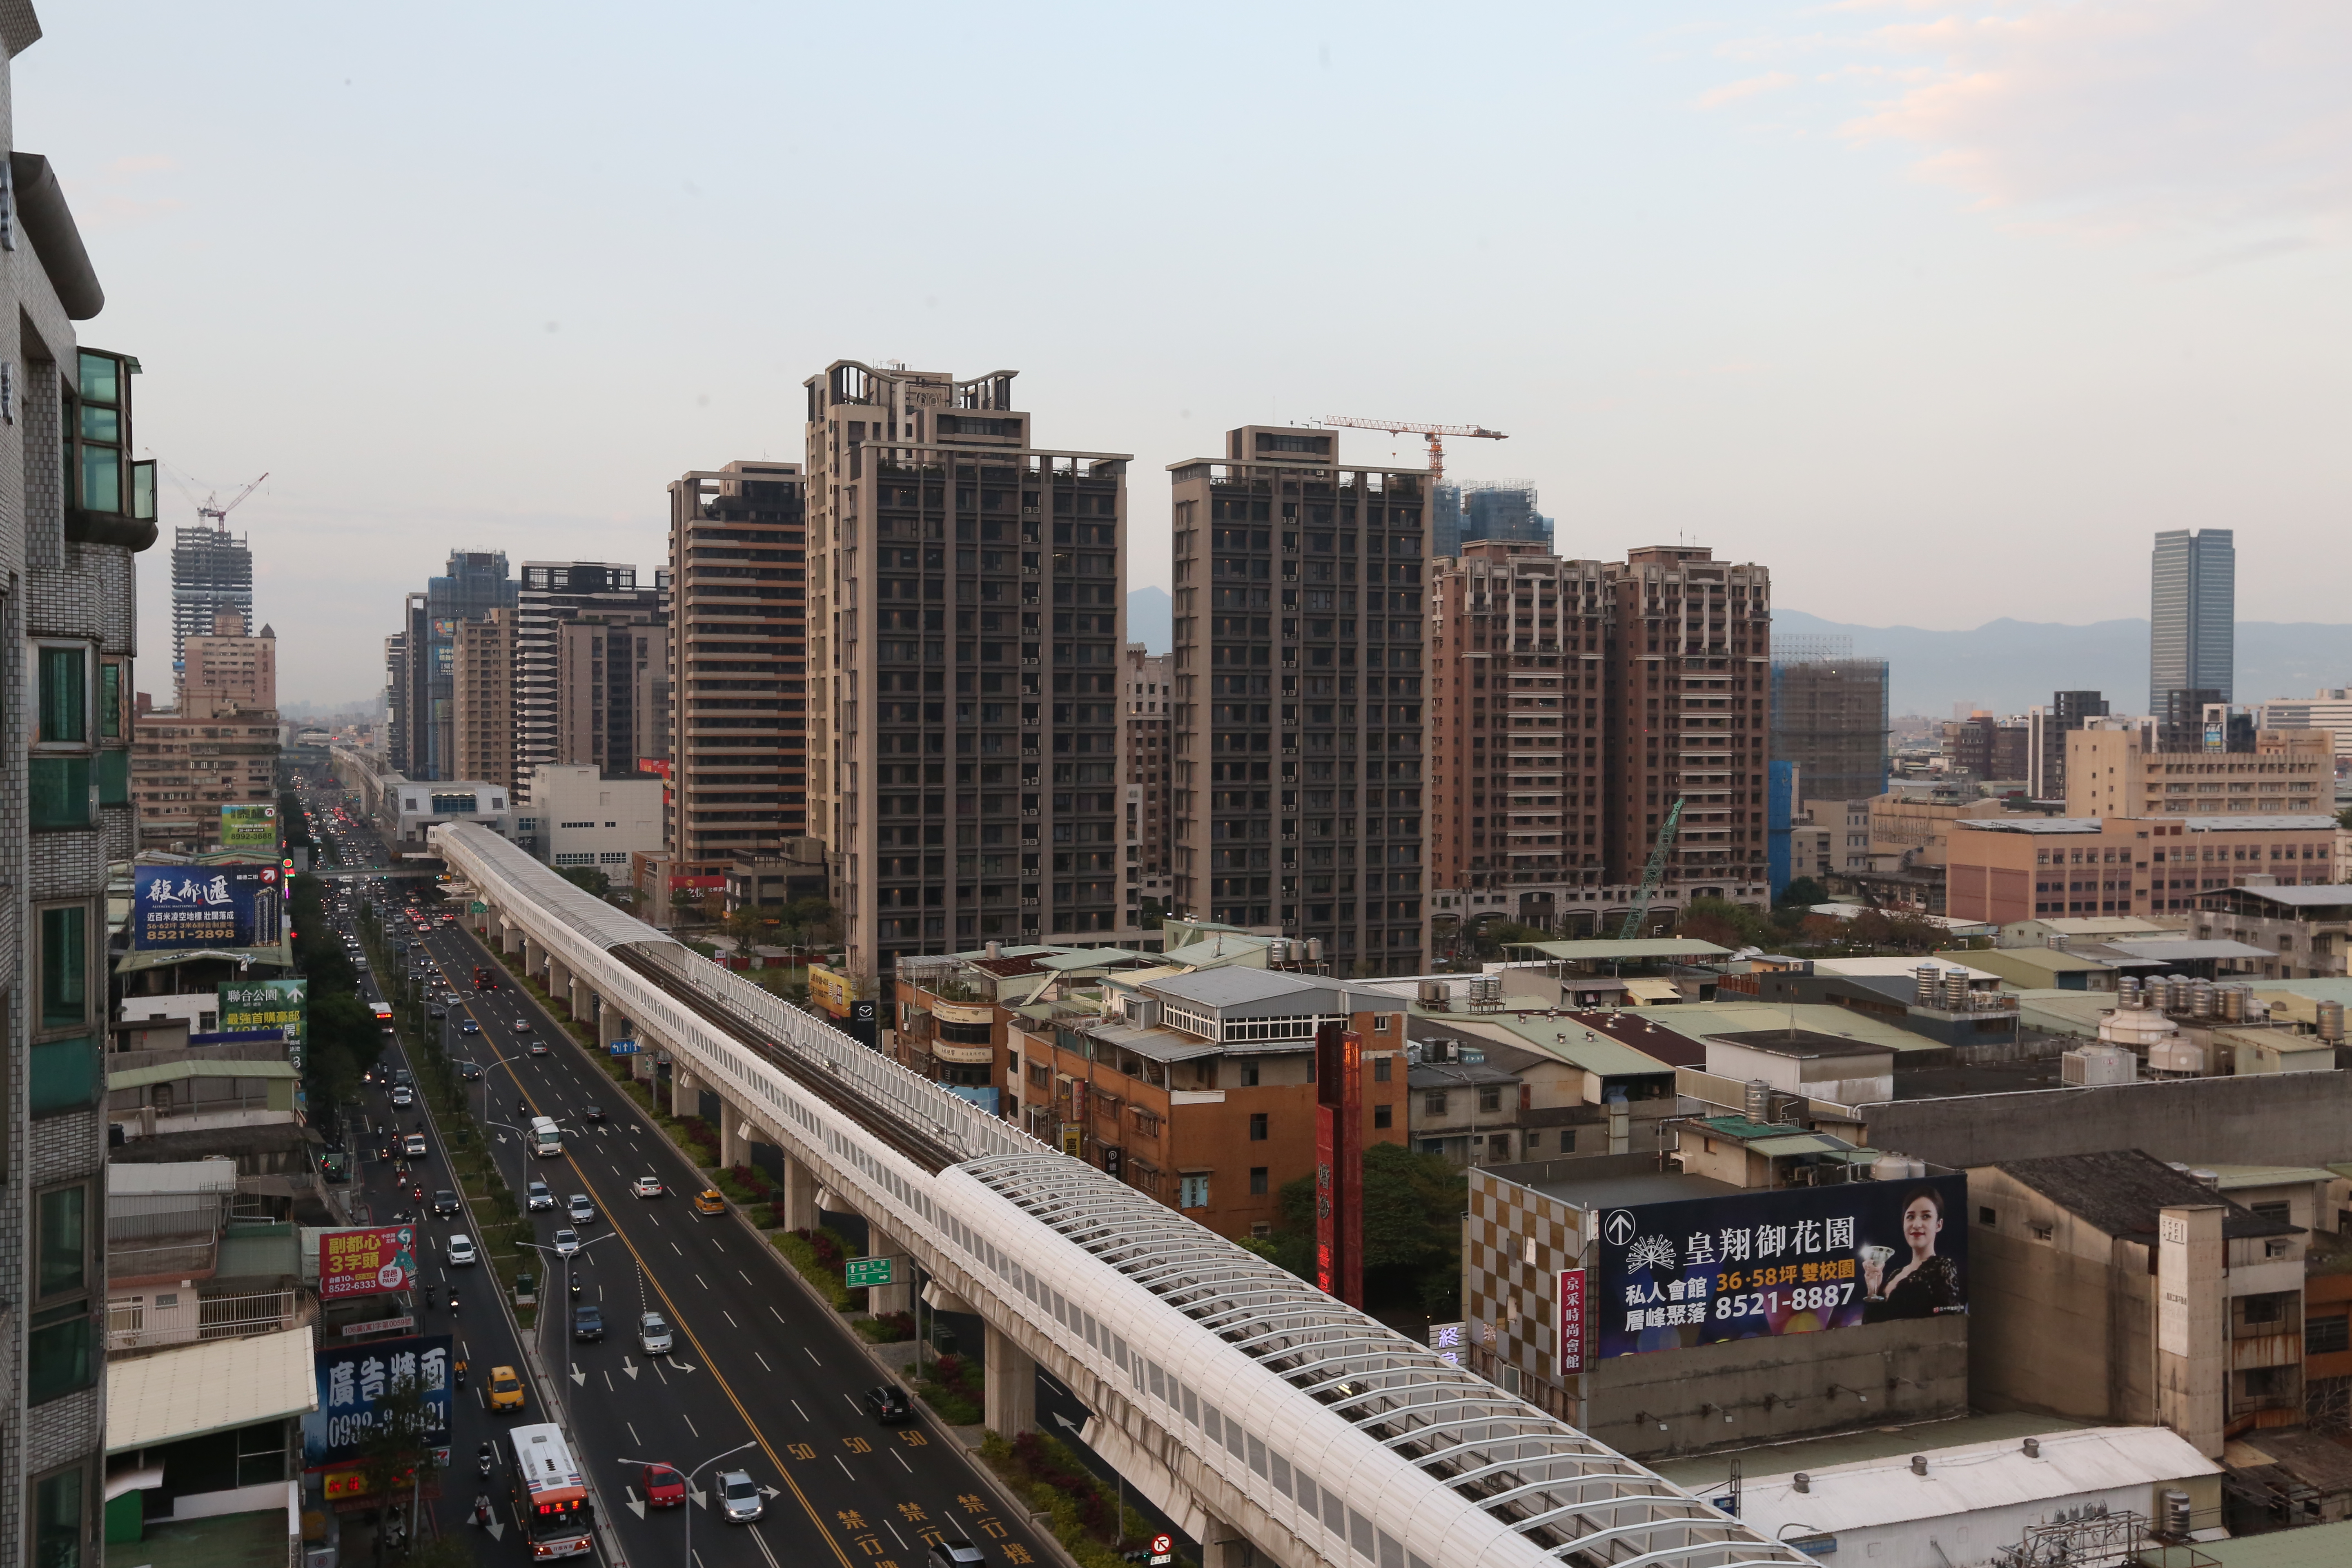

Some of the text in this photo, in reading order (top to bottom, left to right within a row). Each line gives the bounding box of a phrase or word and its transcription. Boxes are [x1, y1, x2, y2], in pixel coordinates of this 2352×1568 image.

[147, 911, 234, 922] 近百米凌空地標 壯闊落成
[147, 929, 235, 940] 8521-2898
[227, 989, 277, 1002] 聯合公園
[227, 1010, 300, 1025] 最強首購豪邸
[1319, 1160, 1330, 1219] 婚紗
[329, 1234, 381, 1255] 副都心
[1683, 1216, 1855, 1267] 皇翔御花園
[329, 1252, 379, 1273] 3字頭
[1802, 1259, 1855, 1283] 雙校園
[329, 1280, 376, 1293] 8522-6333
[1625, 1276, 1707, 1307] 私人會館
[1715, 1283, 1855, 1320] 8521-8887
[1566, 1276, 1579, 1369] 京采時尚會館
[1625, 1302, 1707, 1332] 層峰聚落
[842, 1437, 872, 1454] 50
[898, 1430, 928, 1446] 50
[787, 1443, 816, 1460] 50
[957, 1494, 1035, 1565] 禁行機
